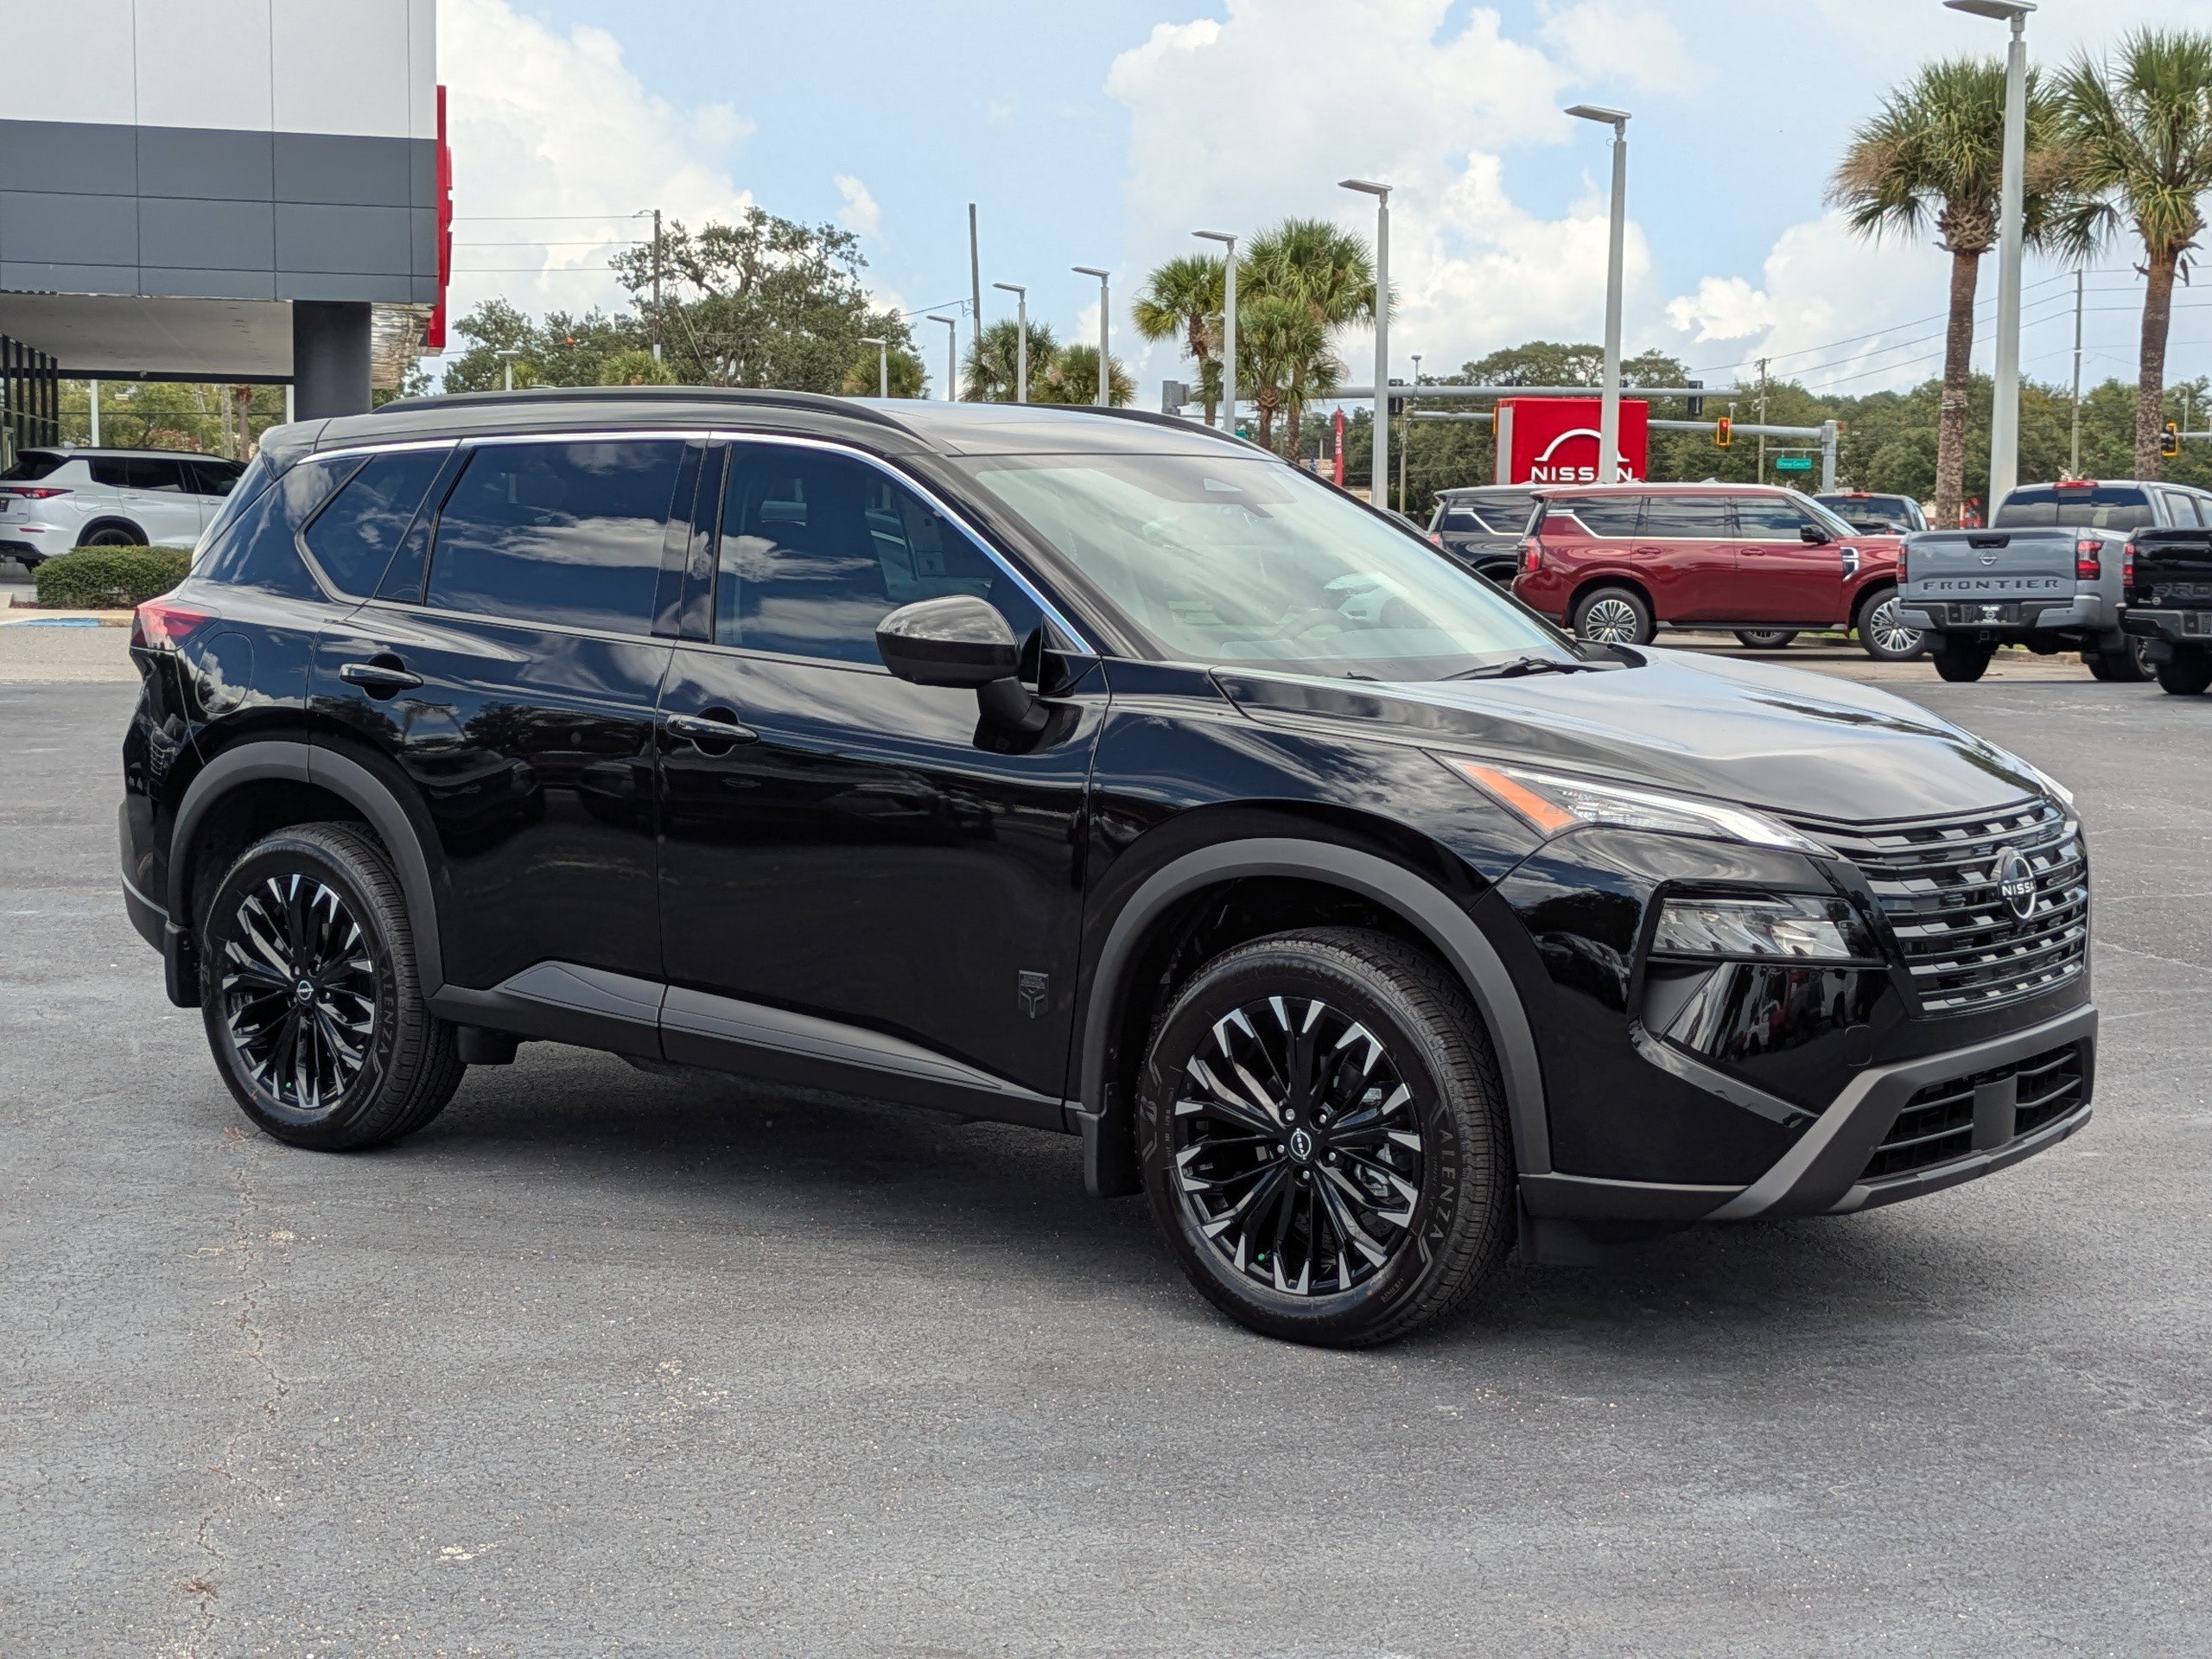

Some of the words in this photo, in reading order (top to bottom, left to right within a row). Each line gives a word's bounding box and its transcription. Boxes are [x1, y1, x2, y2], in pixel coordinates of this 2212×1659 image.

[1530, 466, 1632, 481] NISSN
[1923, 579, 2060, 591] FRONTIER
[378, 966, 395, 1054] ALENZA
[1429, 1128, 1456, 1238] ALENZA
